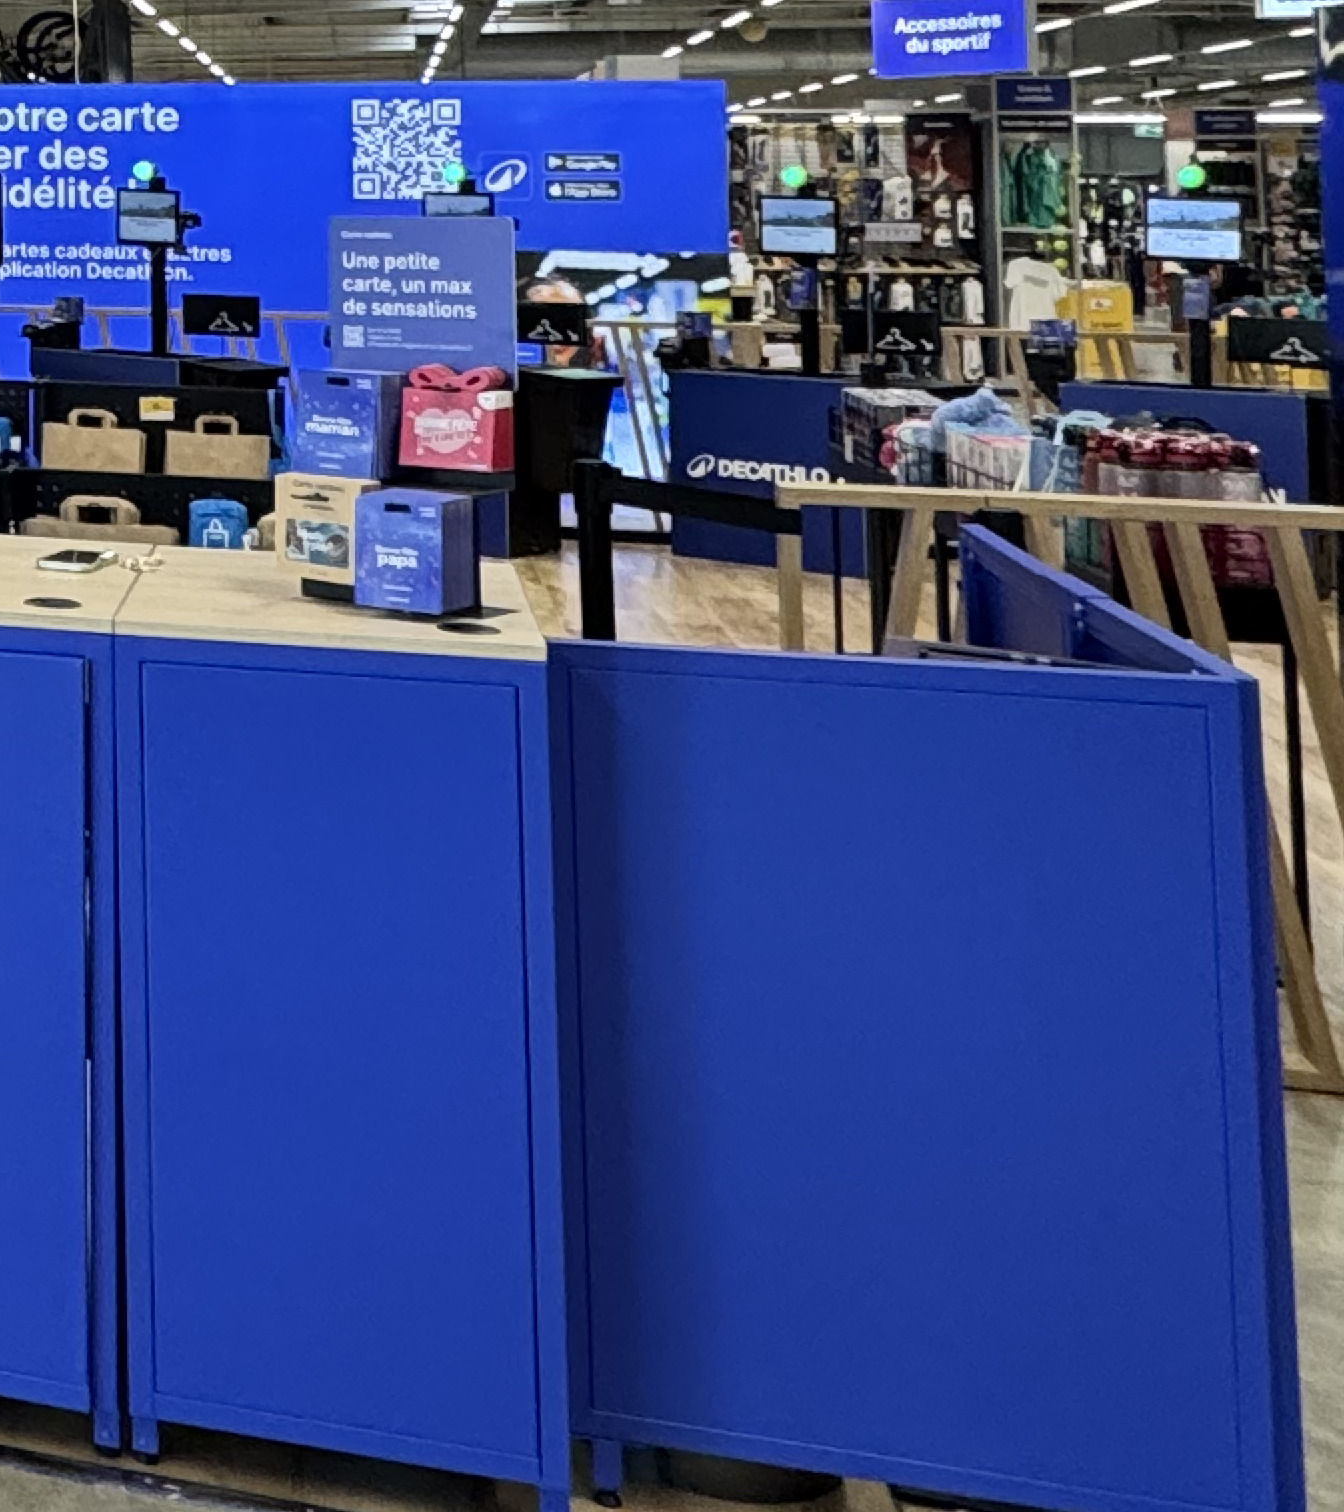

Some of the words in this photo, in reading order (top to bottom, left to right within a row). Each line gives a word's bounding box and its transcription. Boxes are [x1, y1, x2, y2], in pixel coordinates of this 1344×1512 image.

[894, 11, 1003, 35] Accessoires
[906, 37, 929, 54] du
[932, 31, 992, 55] sportif
[77, 102, 180, 132] carte
[38, 139, 110, 170] des
[2, 175, 116, 209] idélité
[2, 242, 50, 259] artes
[54, 243, 139, 262] cadeaux
[342, 250, 380, 270] Une
[384, 251, 441, 274] petite
[342, 276, 398, 297] carte,
[401, 279, 426, 294] un
[430, 279, 473, 295] max
[342, 297, 368, 316] de
[371, 299, 478, 320] sensations
[305, 421, 360, 437] maman
[717, 458, 846, 486] DECATHLO
[376, 554, 418, 570] papa
